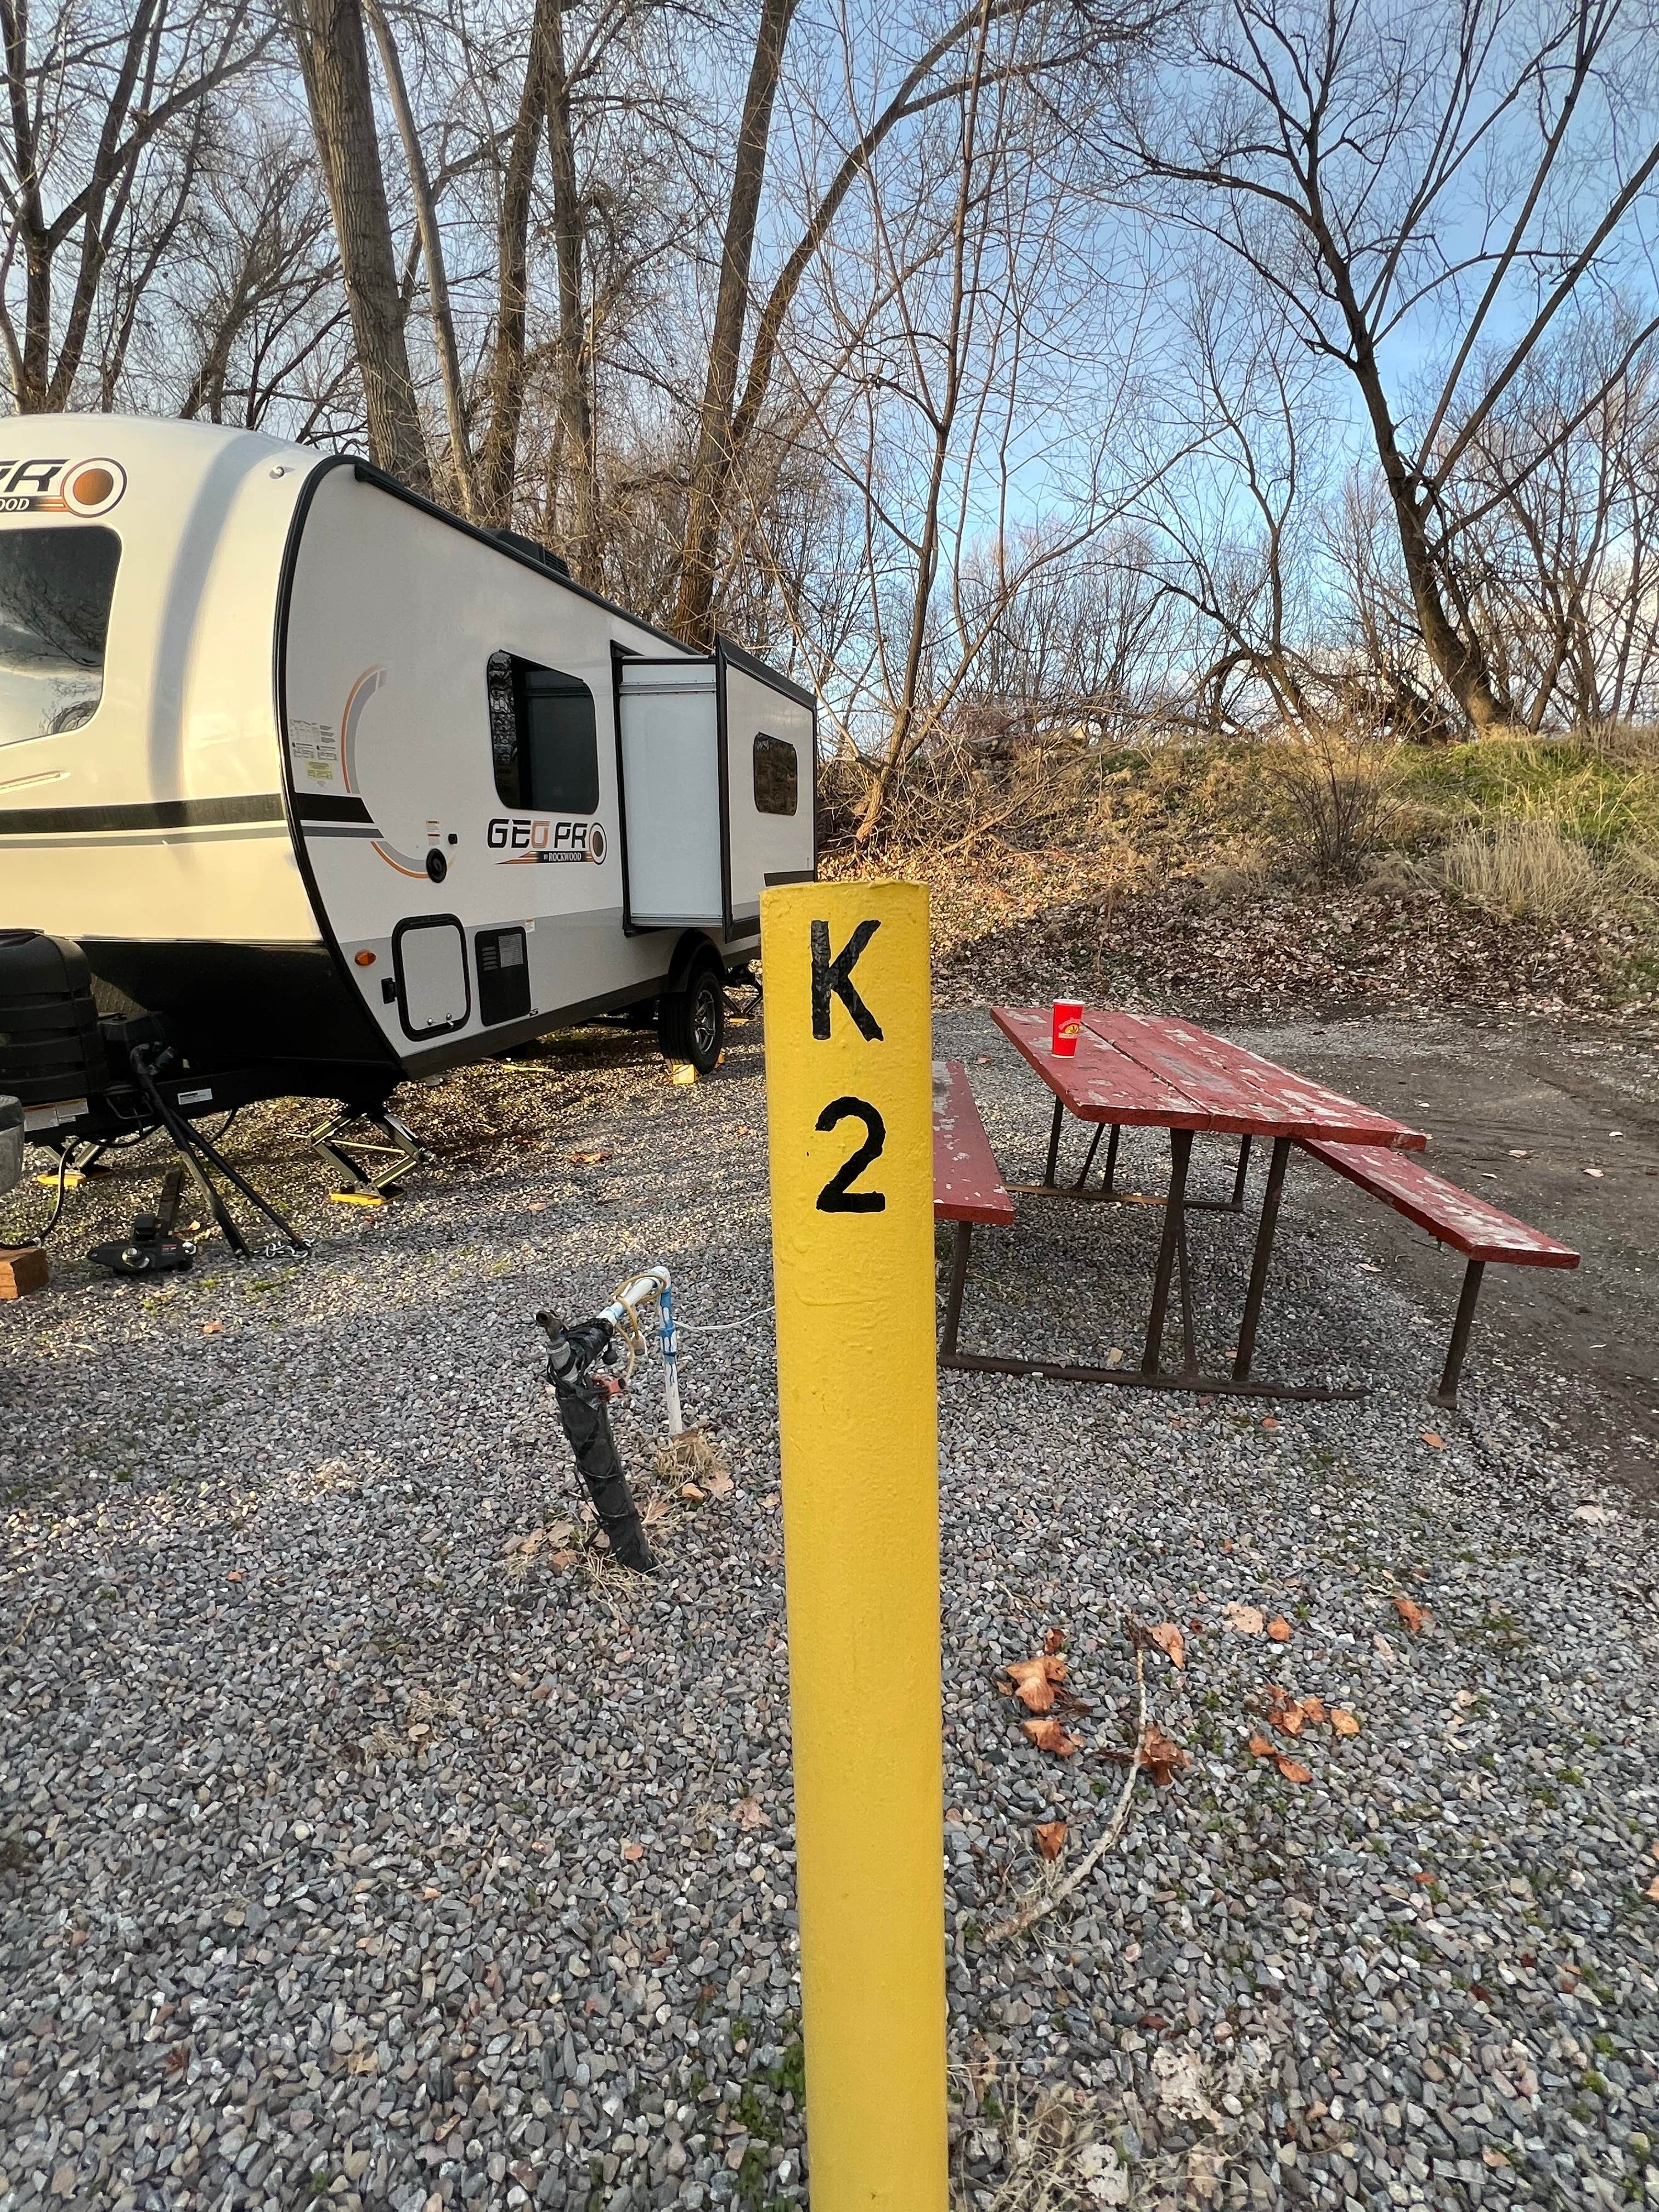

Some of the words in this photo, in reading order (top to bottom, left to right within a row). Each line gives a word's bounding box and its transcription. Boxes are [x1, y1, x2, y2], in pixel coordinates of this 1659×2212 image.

[487, 819, 551, 848] GEO
[549, 852, 582, 861] ROCKWOOD
[811, 919, 884, 1042] K
[815, 1096, 887, 1213] 2
